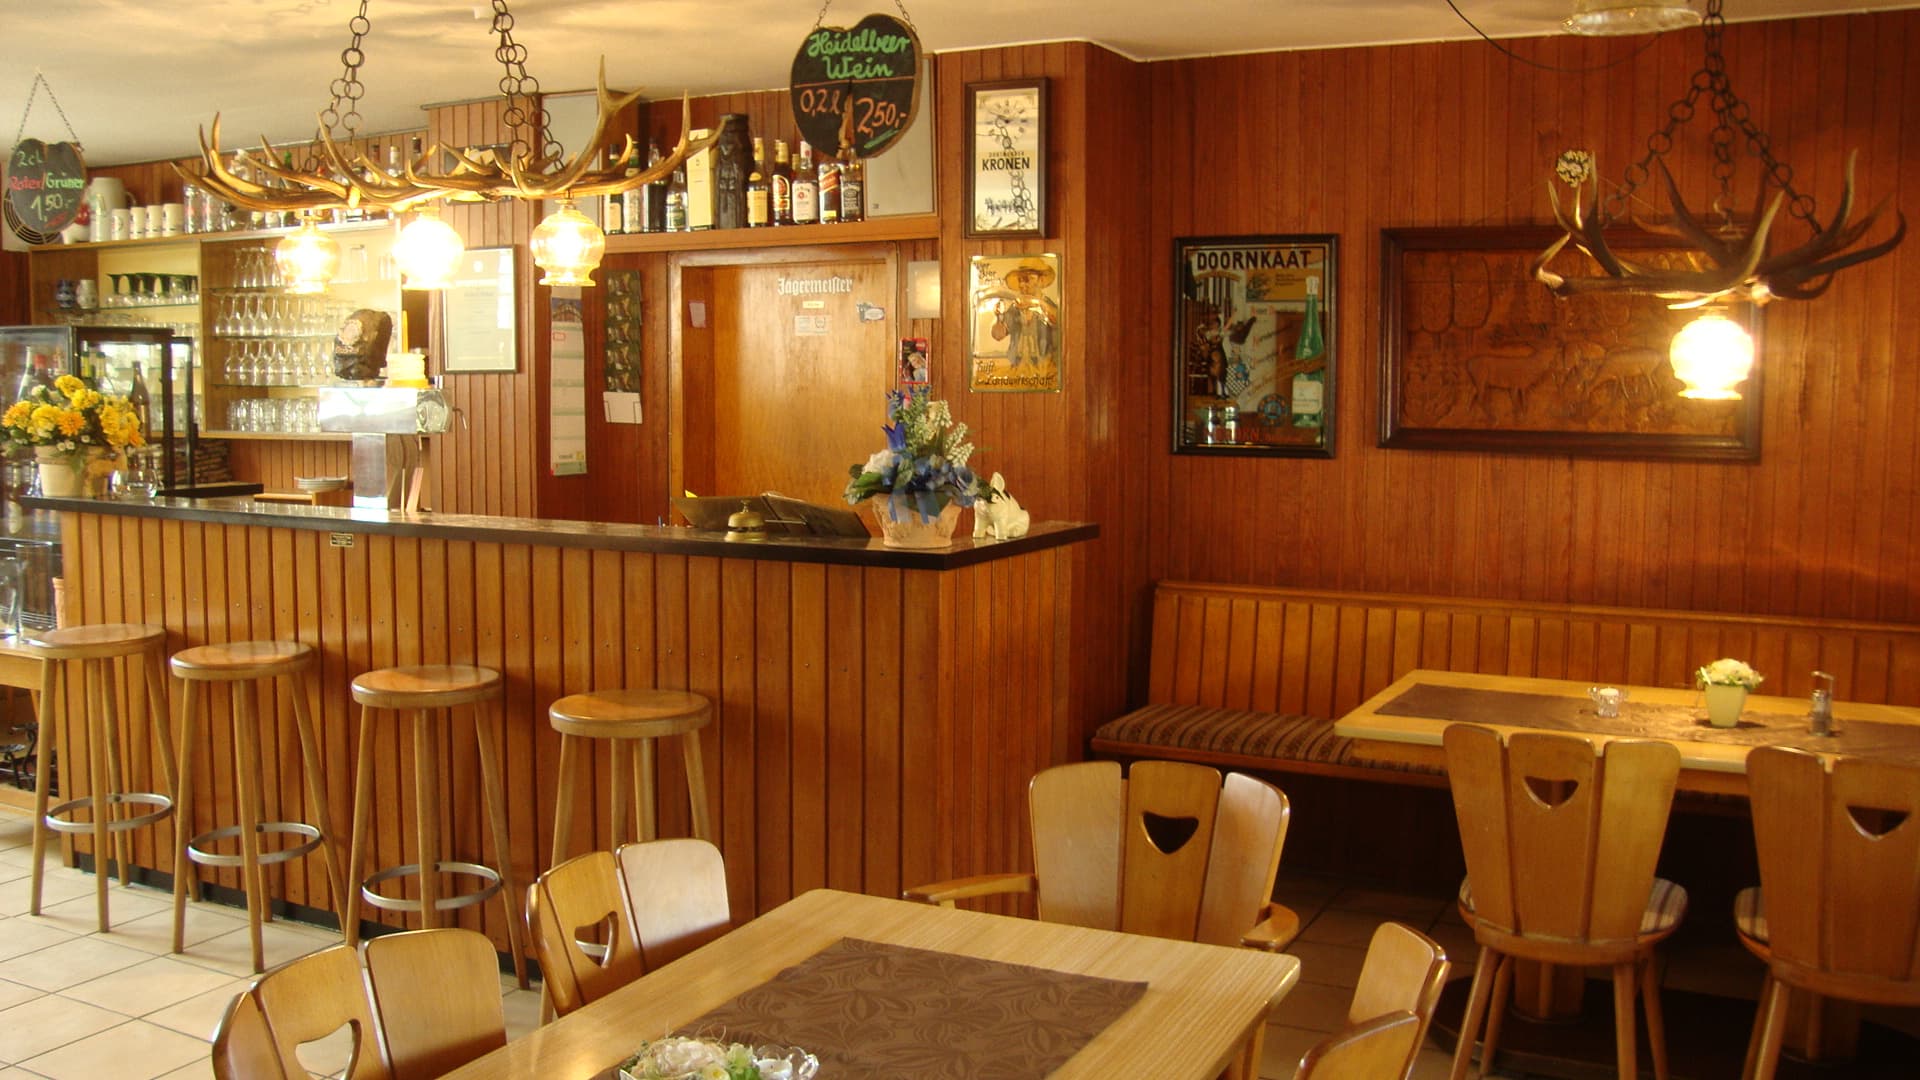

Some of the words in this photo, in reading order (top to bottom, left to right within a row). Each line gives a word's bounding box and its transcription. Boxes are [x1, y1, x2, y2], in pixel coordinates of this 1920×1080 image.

[807, 28, 911, 57] Heidelbeer
[822, 56, 893, 79] Wein
[981, 157, 1030, 171] KRONEN
[1197, 250, 1311, 271] DOORNKAAT
